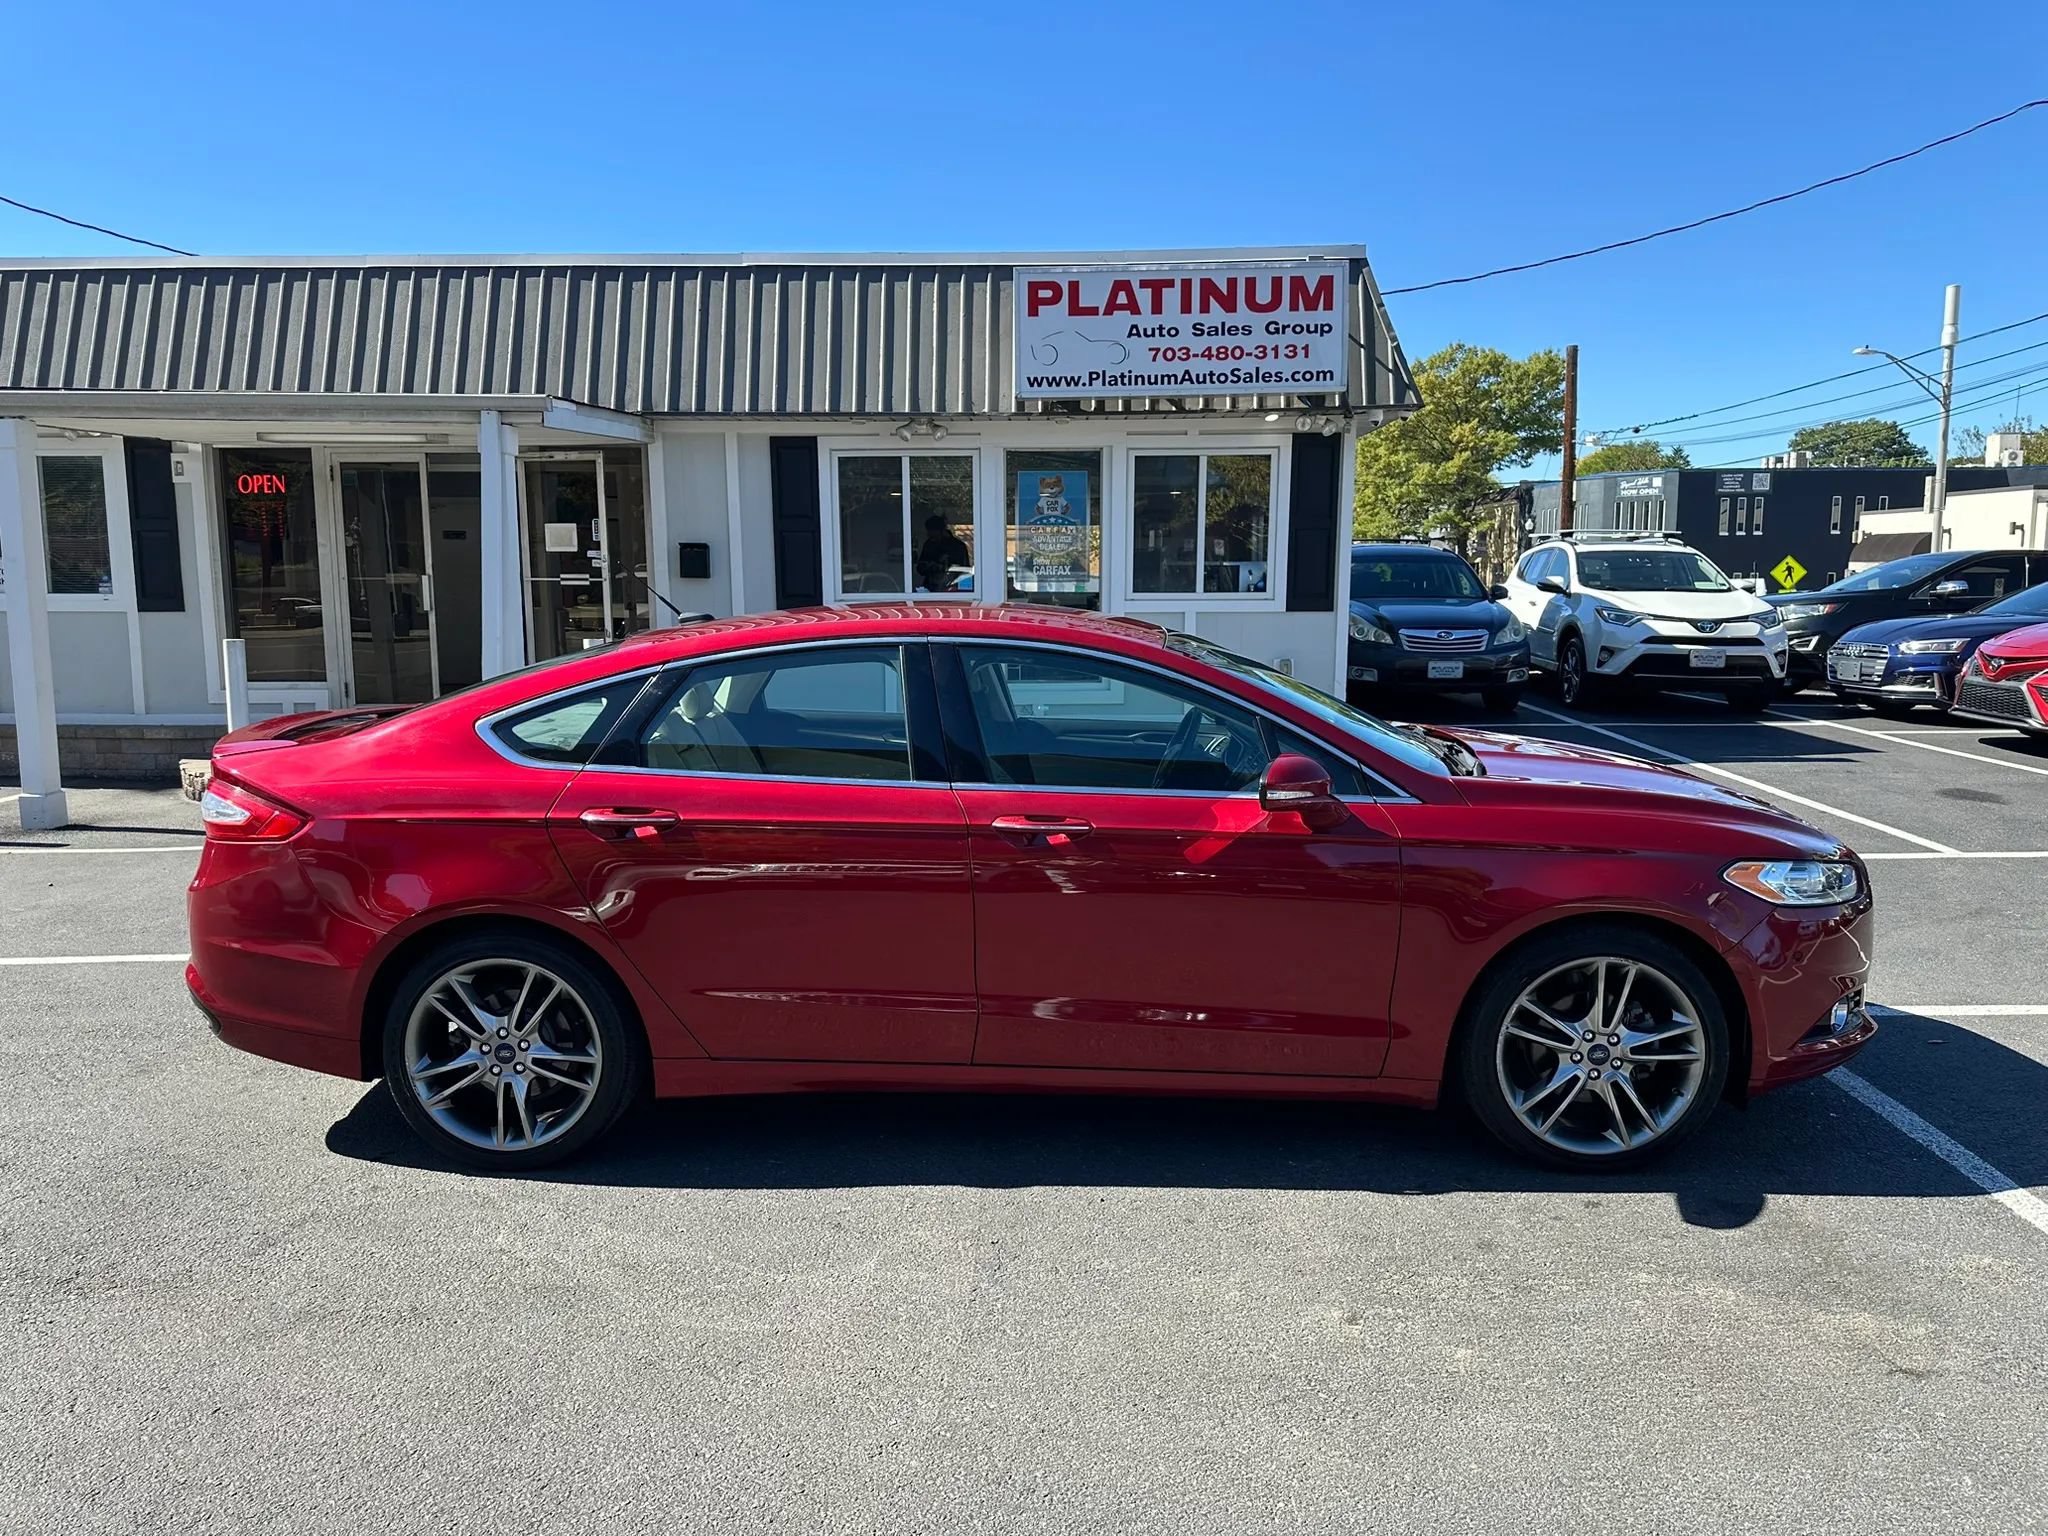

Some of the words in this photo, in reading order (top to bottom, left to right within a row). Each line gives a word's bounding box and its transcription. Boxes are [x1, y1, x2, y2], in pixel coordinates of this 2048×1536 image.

[1027, 275, 1335, 317] PLATINUM
[1126, 322, 1180, 339] Auto
[1191, 321, 1253, 338] Sales
[1264, 321, 1334, 337] Group
[1148, 344, 1311, 362] 703-480-3131
[1027, 367, 1334, 388] www.PlatinumAutoSales.com
[238, 474, 286, 494] OPEN
[1033, 565, 1072, 576] CARFAX
